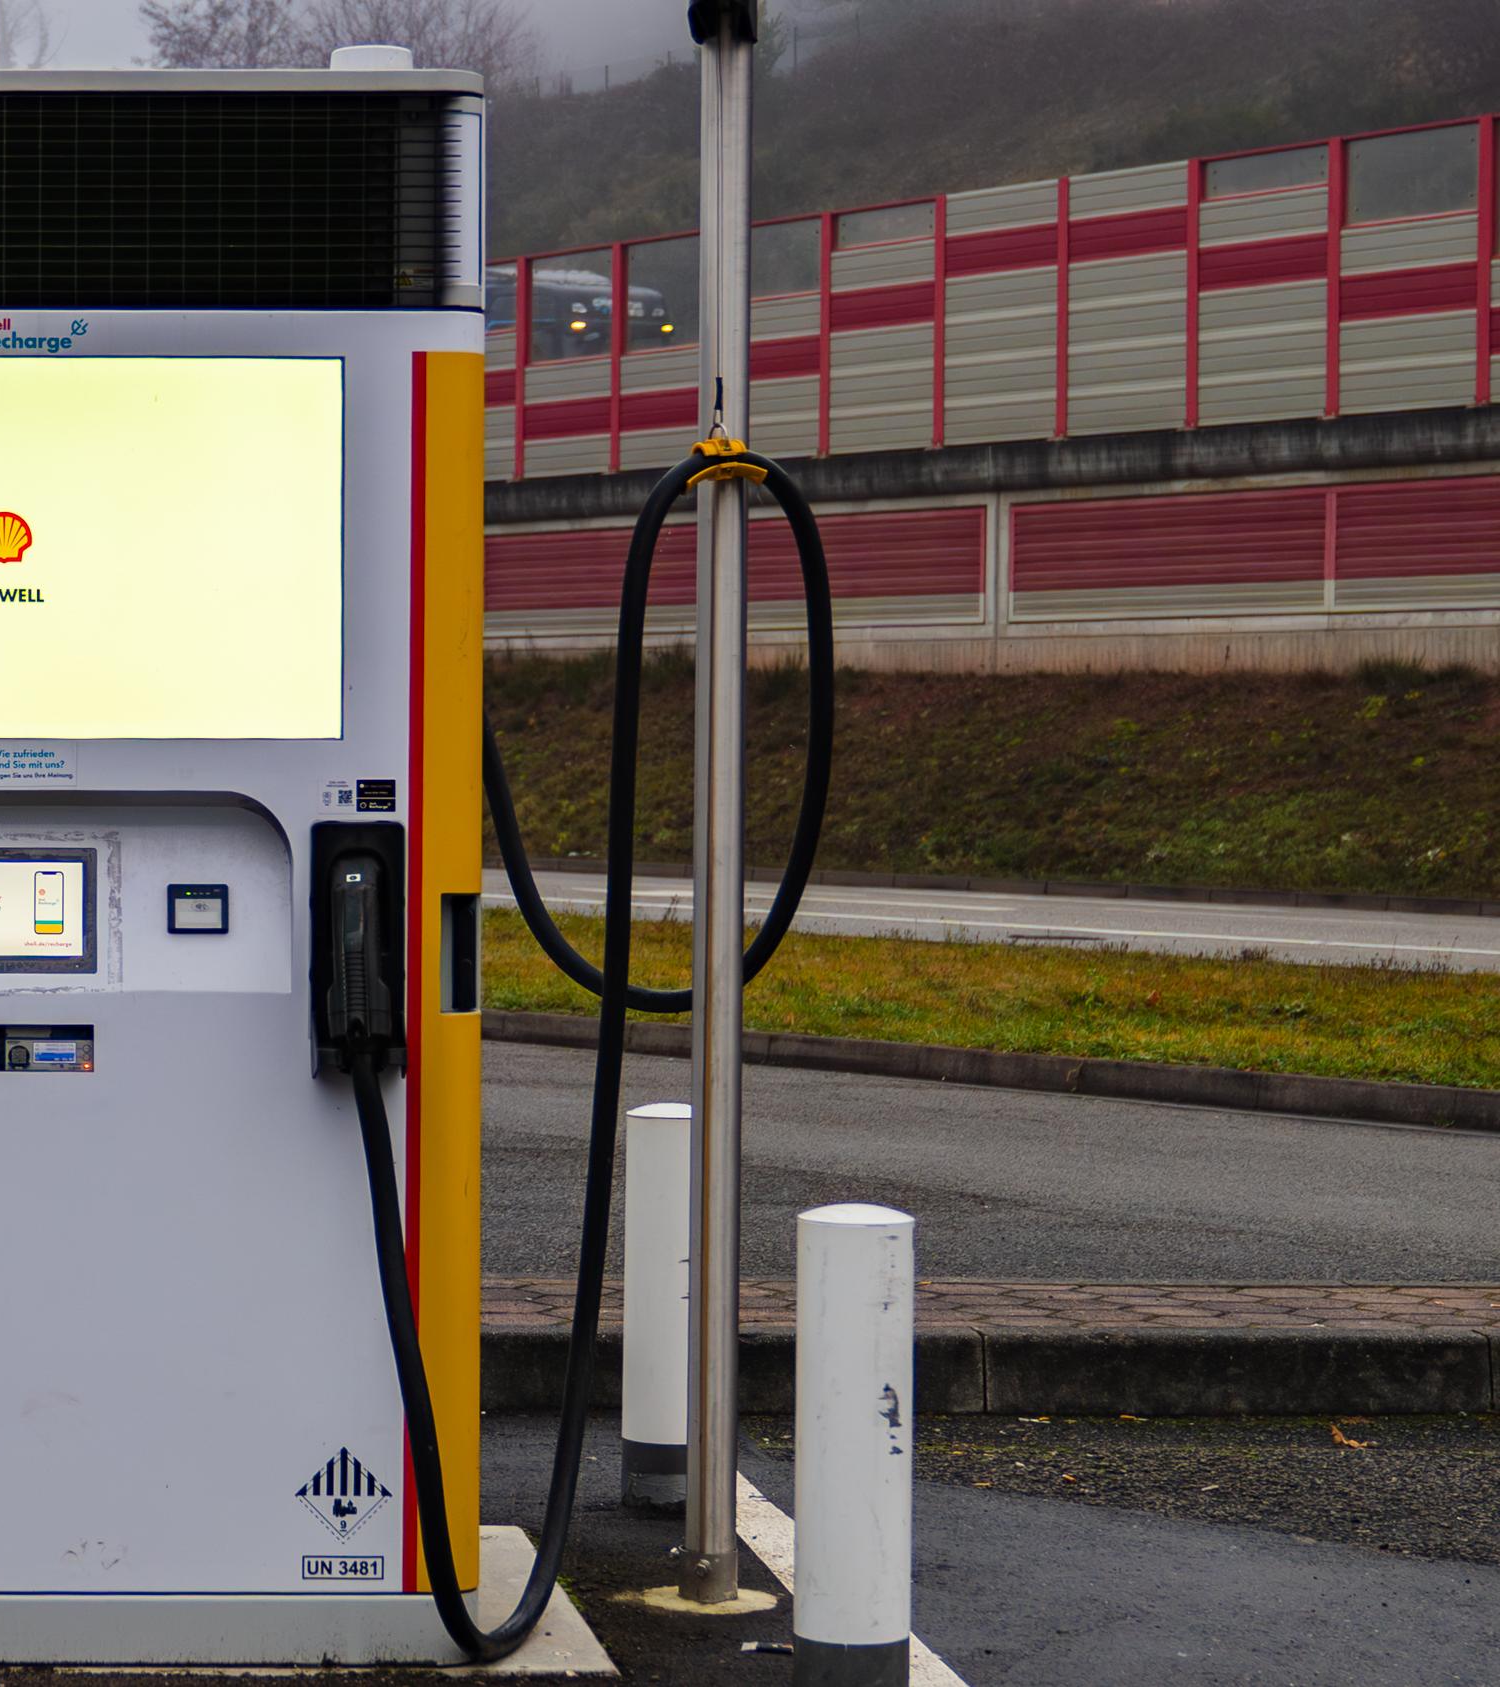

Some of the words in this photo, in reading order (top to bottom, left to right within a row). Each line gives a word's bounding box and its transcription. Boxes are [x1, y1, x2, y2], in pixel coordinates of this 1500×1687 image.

[13, 749, 55, 758] zufrieden
[13, 760, 27, 769] Sie
[29, 760, 43, 769] mit
[45, 760, 66, 769] uns?
[340, 1520, 347, 1529] 9
[307, 1560, 333, 1575] UN
[339, 1560, 378, 1575] 3481
